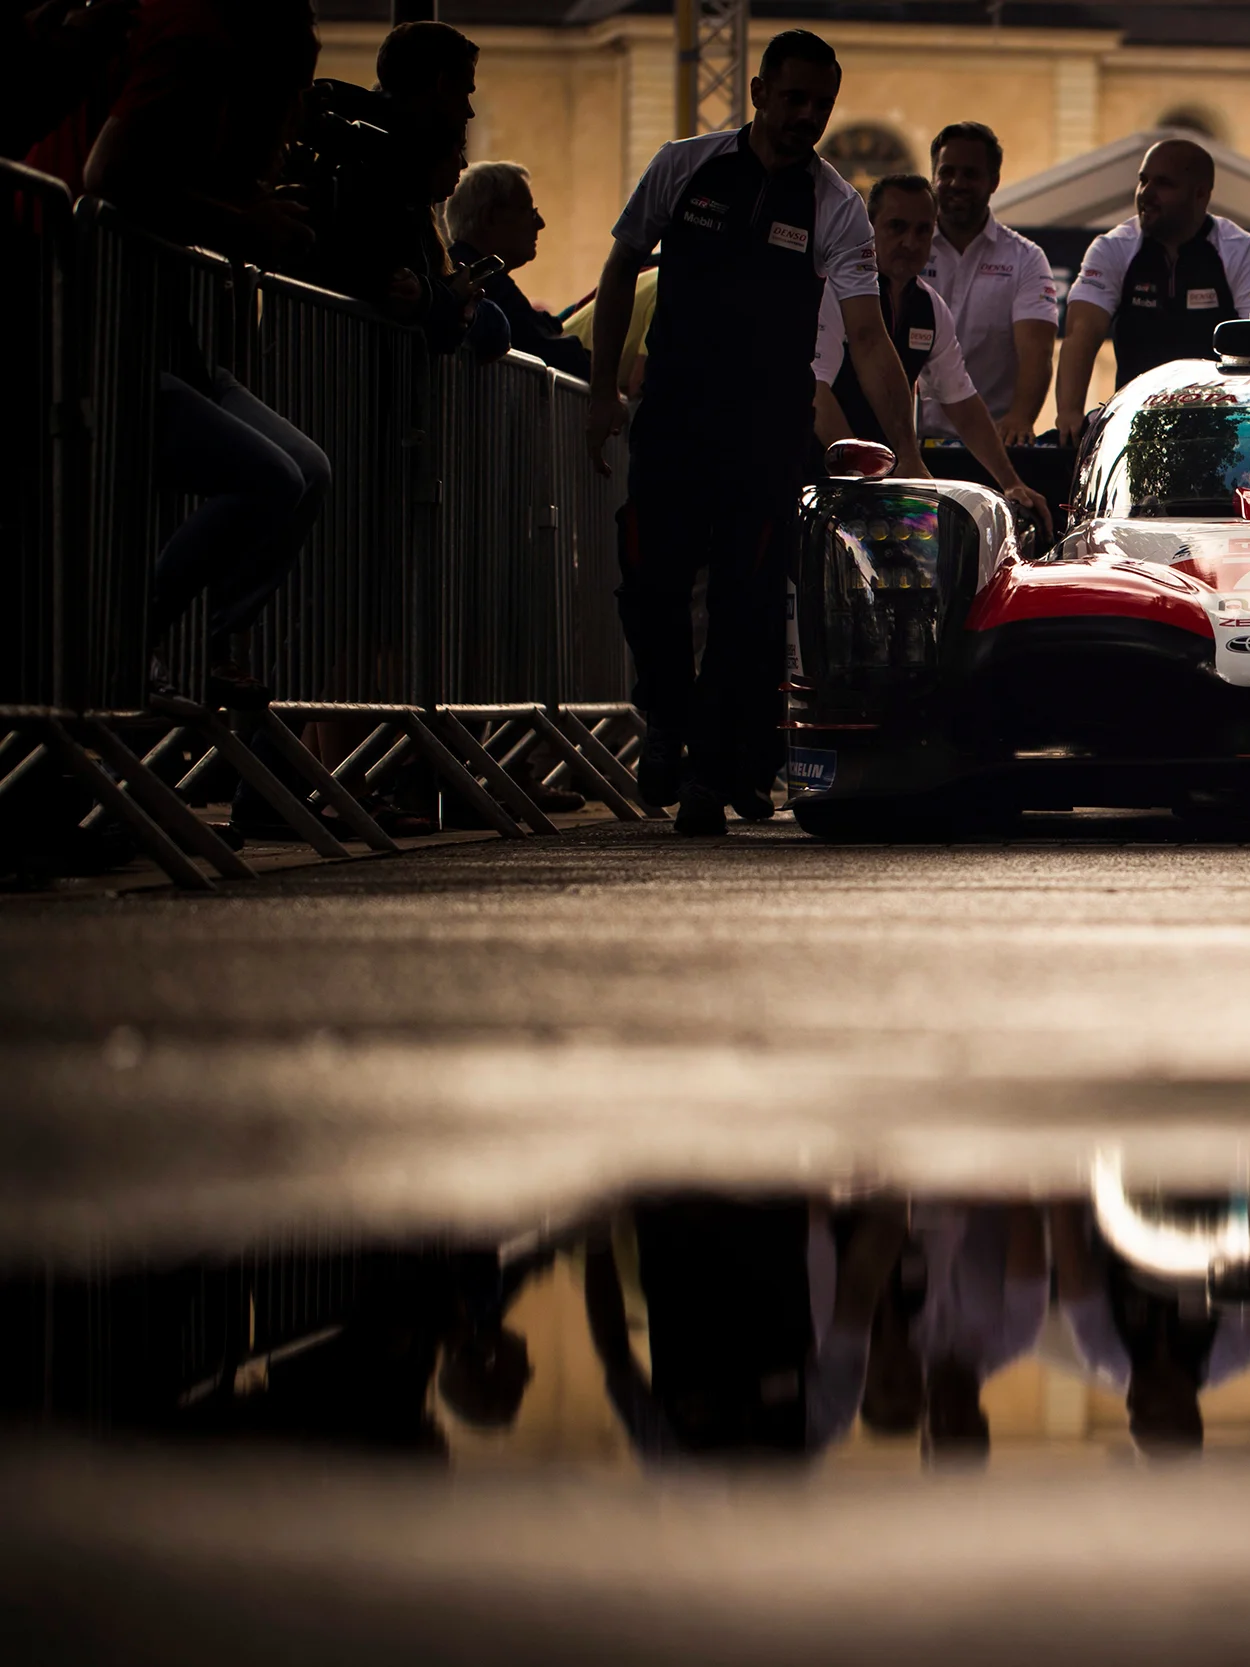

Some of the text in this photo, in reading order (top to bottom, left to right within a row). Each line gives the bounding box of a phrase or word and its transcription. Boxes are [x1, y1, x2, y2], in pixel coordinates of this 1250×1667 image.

[683, 210, 713, 229] Mobil
[773, 226, 807, 242] DENSO
[980, 262, 1014, 273] DENSO
[910, 331, 933, 341] DENSO
